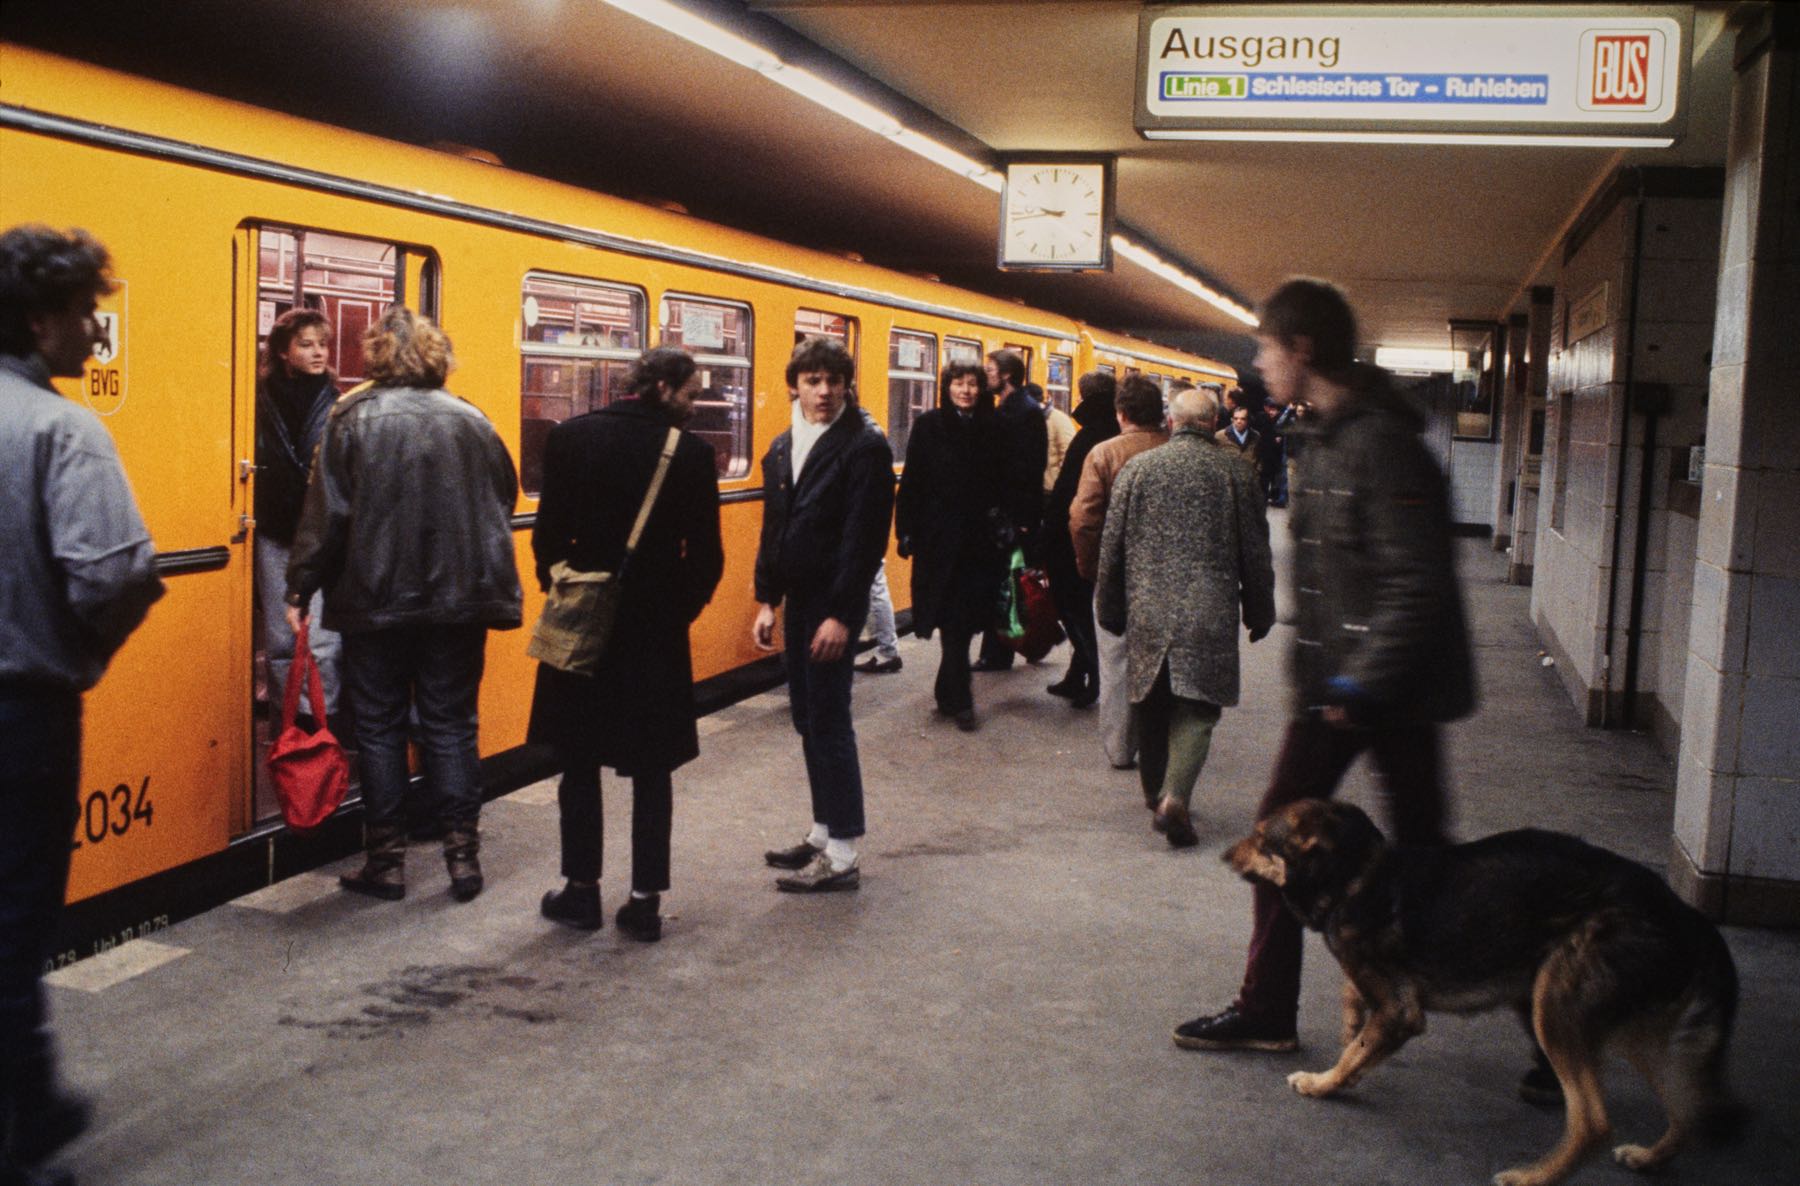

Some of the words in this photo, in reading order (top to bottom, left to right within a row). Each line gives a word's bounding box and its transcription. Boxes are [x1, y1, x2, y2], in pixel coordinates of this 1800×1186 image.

[1160, 27, 1340, 68] Ausgang
[1171, 77, 1219, 96] Linie
[1227, 78, 1238, 96] 1
[1251, 76, 1382, 97] Schlesisches
[1386, 76, 1420, 97] Tor
[1446, 77, 1546, 98] Ruhleben
[1595, 41, 1648, 99] BUS
[91, 369, 119, 396] BVG
